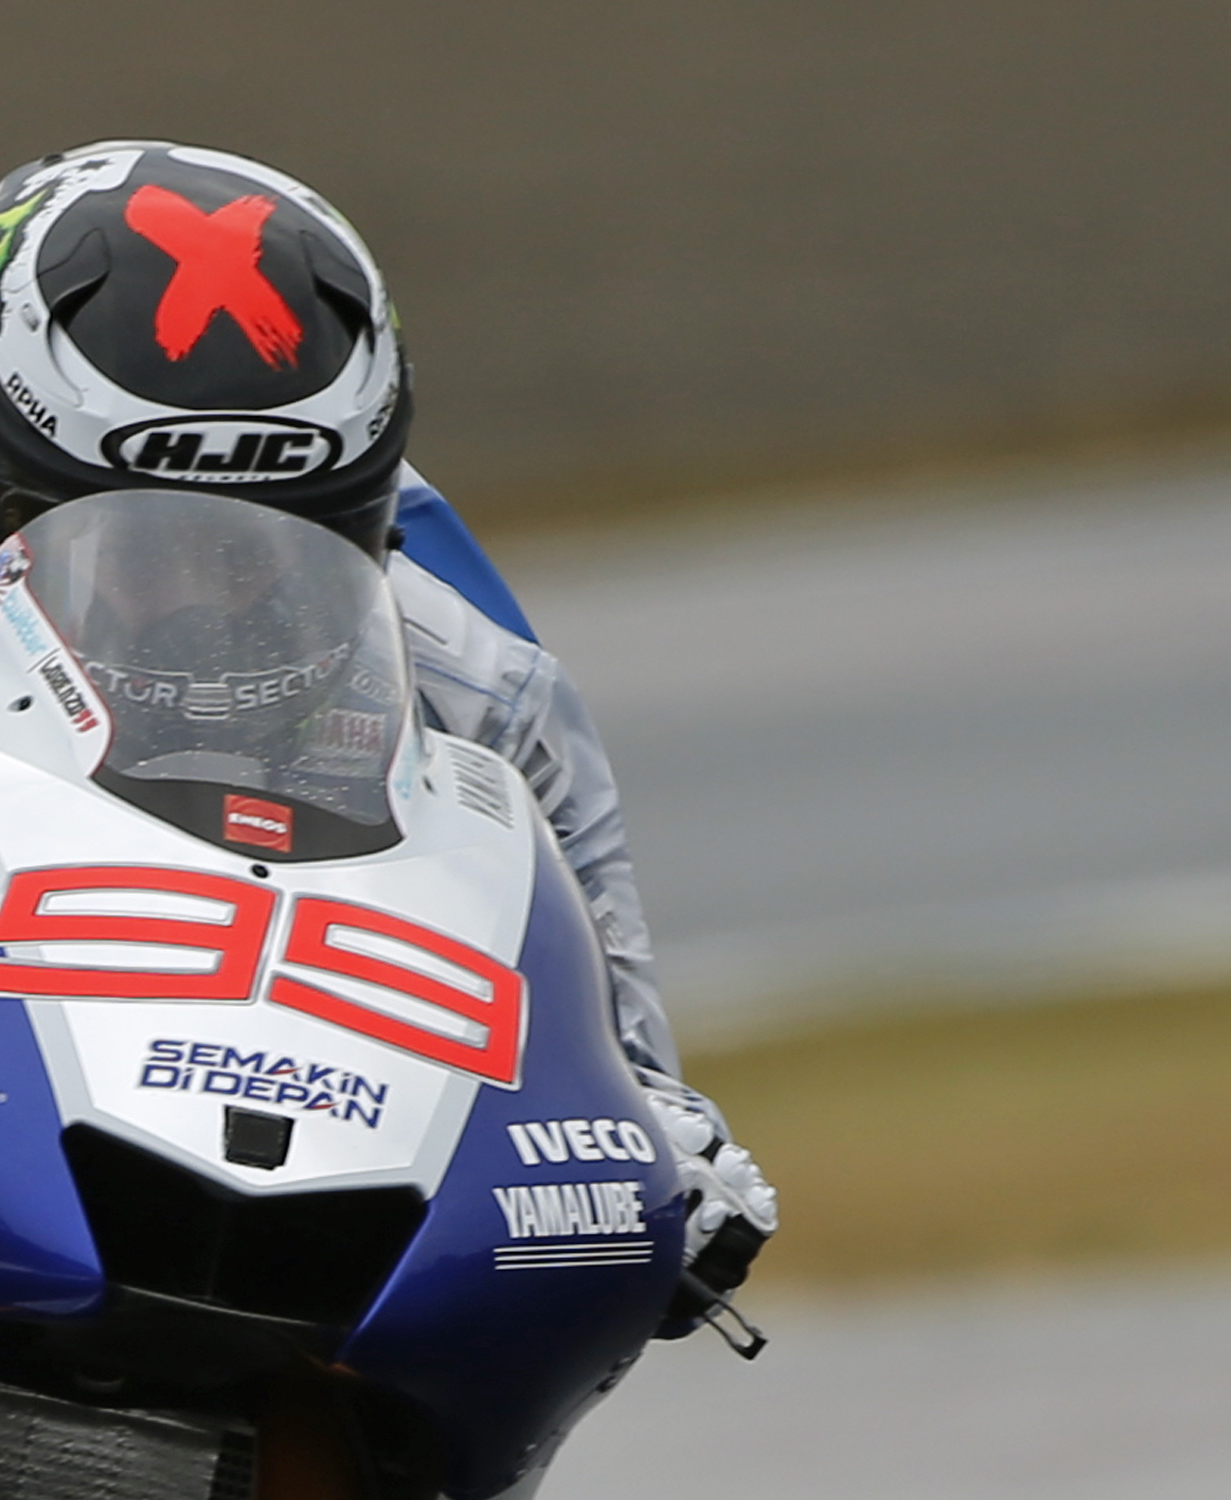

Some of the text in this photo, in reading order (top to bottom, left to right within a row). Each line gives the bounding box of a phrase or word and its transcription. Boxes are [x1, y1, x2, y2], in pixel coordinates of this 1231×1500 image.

[132, 432, 315, 472] HJC
[228, 812, 288, 835] ENEOS
[201, 1069, 382, 1129] DEPAN
[506, 1118, 657, 1166] IVECO
[491, 1180, 647, 1240] YAMALUBE
